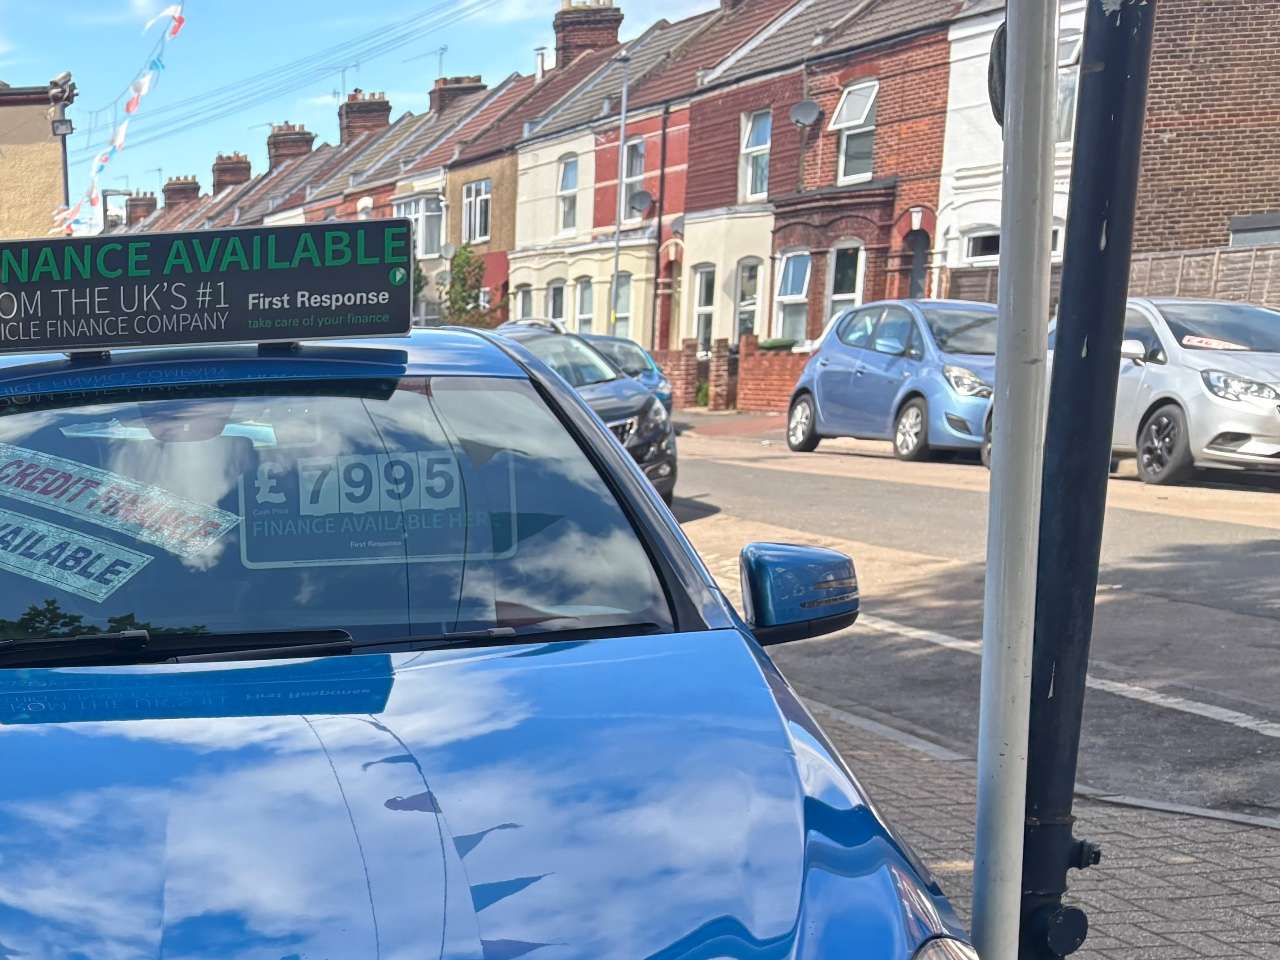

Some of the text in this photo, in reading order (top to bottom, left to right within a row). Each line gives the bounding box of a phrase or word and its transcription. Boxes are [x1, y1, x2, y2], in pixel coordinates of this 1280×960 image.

[162, 226, 408, 276] AVAILABLE
[50, 287, 111, 316] THE
[196, 281, 230, 309] #1
[247, 290, 390, 311] First Response
[46, 315, 129, 339] FINANCE
[133, 311, 230, 335] COMPANY
[247, 311, 390, 329] take care of your finance
[252, 518, 336, 537] FINANCE
[340, 512, 444, 535] AVAILABLE
